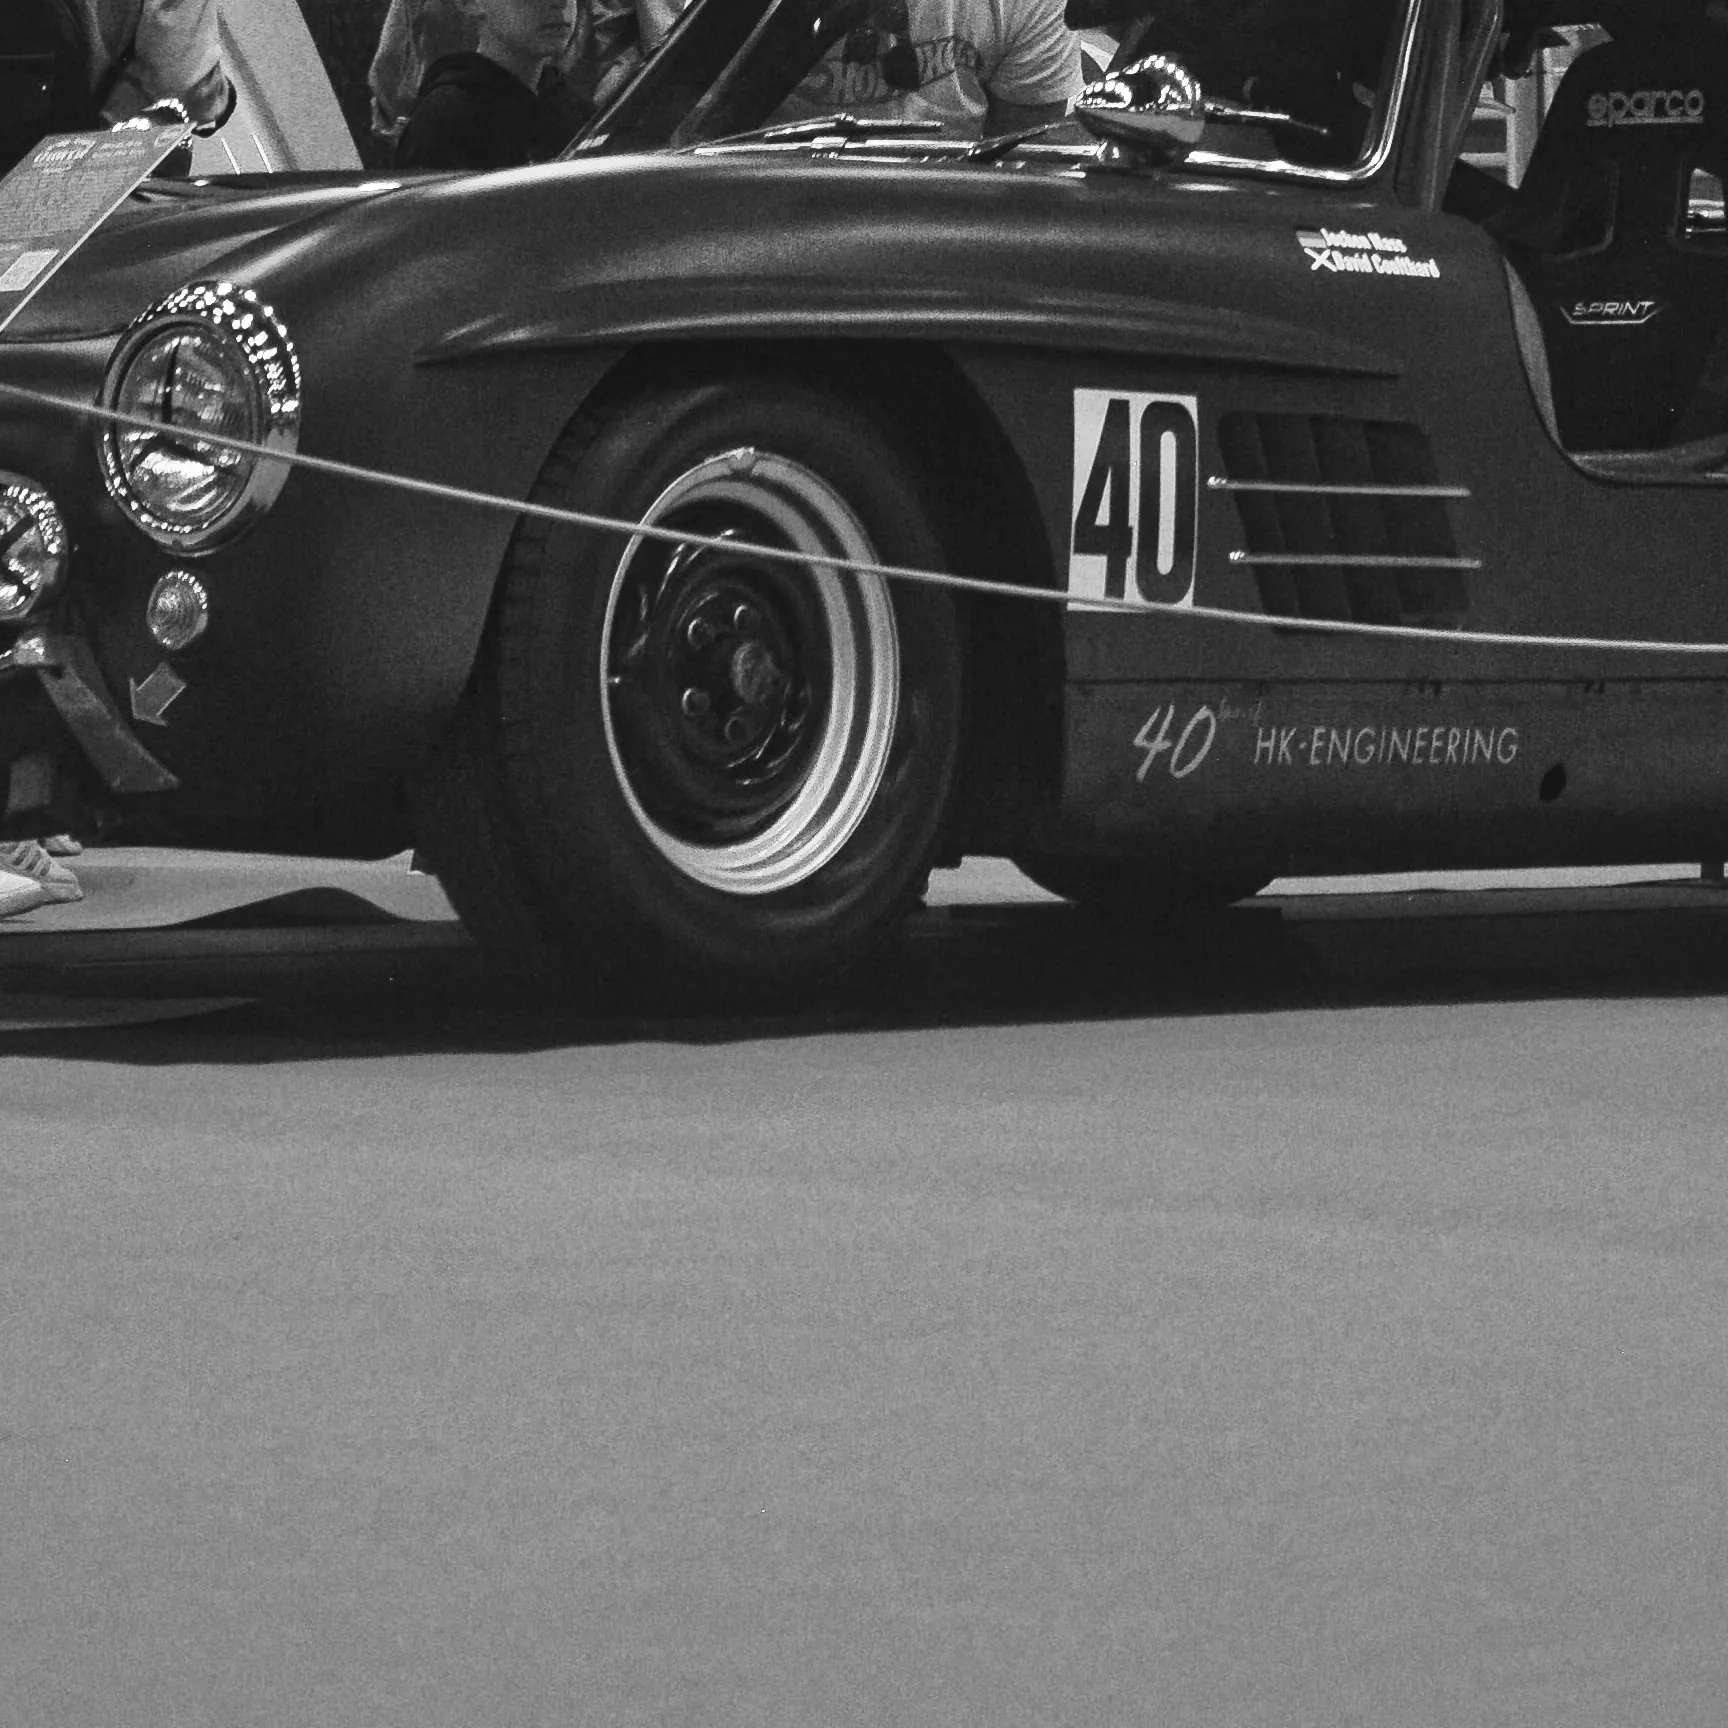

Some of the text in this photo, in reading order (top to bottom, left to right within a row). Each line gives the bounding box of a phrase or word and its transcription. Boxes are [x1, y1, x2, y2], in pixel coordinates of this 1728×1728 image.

[1586, 89, 1705, 128] sparco
[1330, 250, 1374, 273] David
[1572, 301, 1656, 316] SPRINT
[1073, 398, 1198, 606] 40
[1132, 702, 1218, 785] 40
